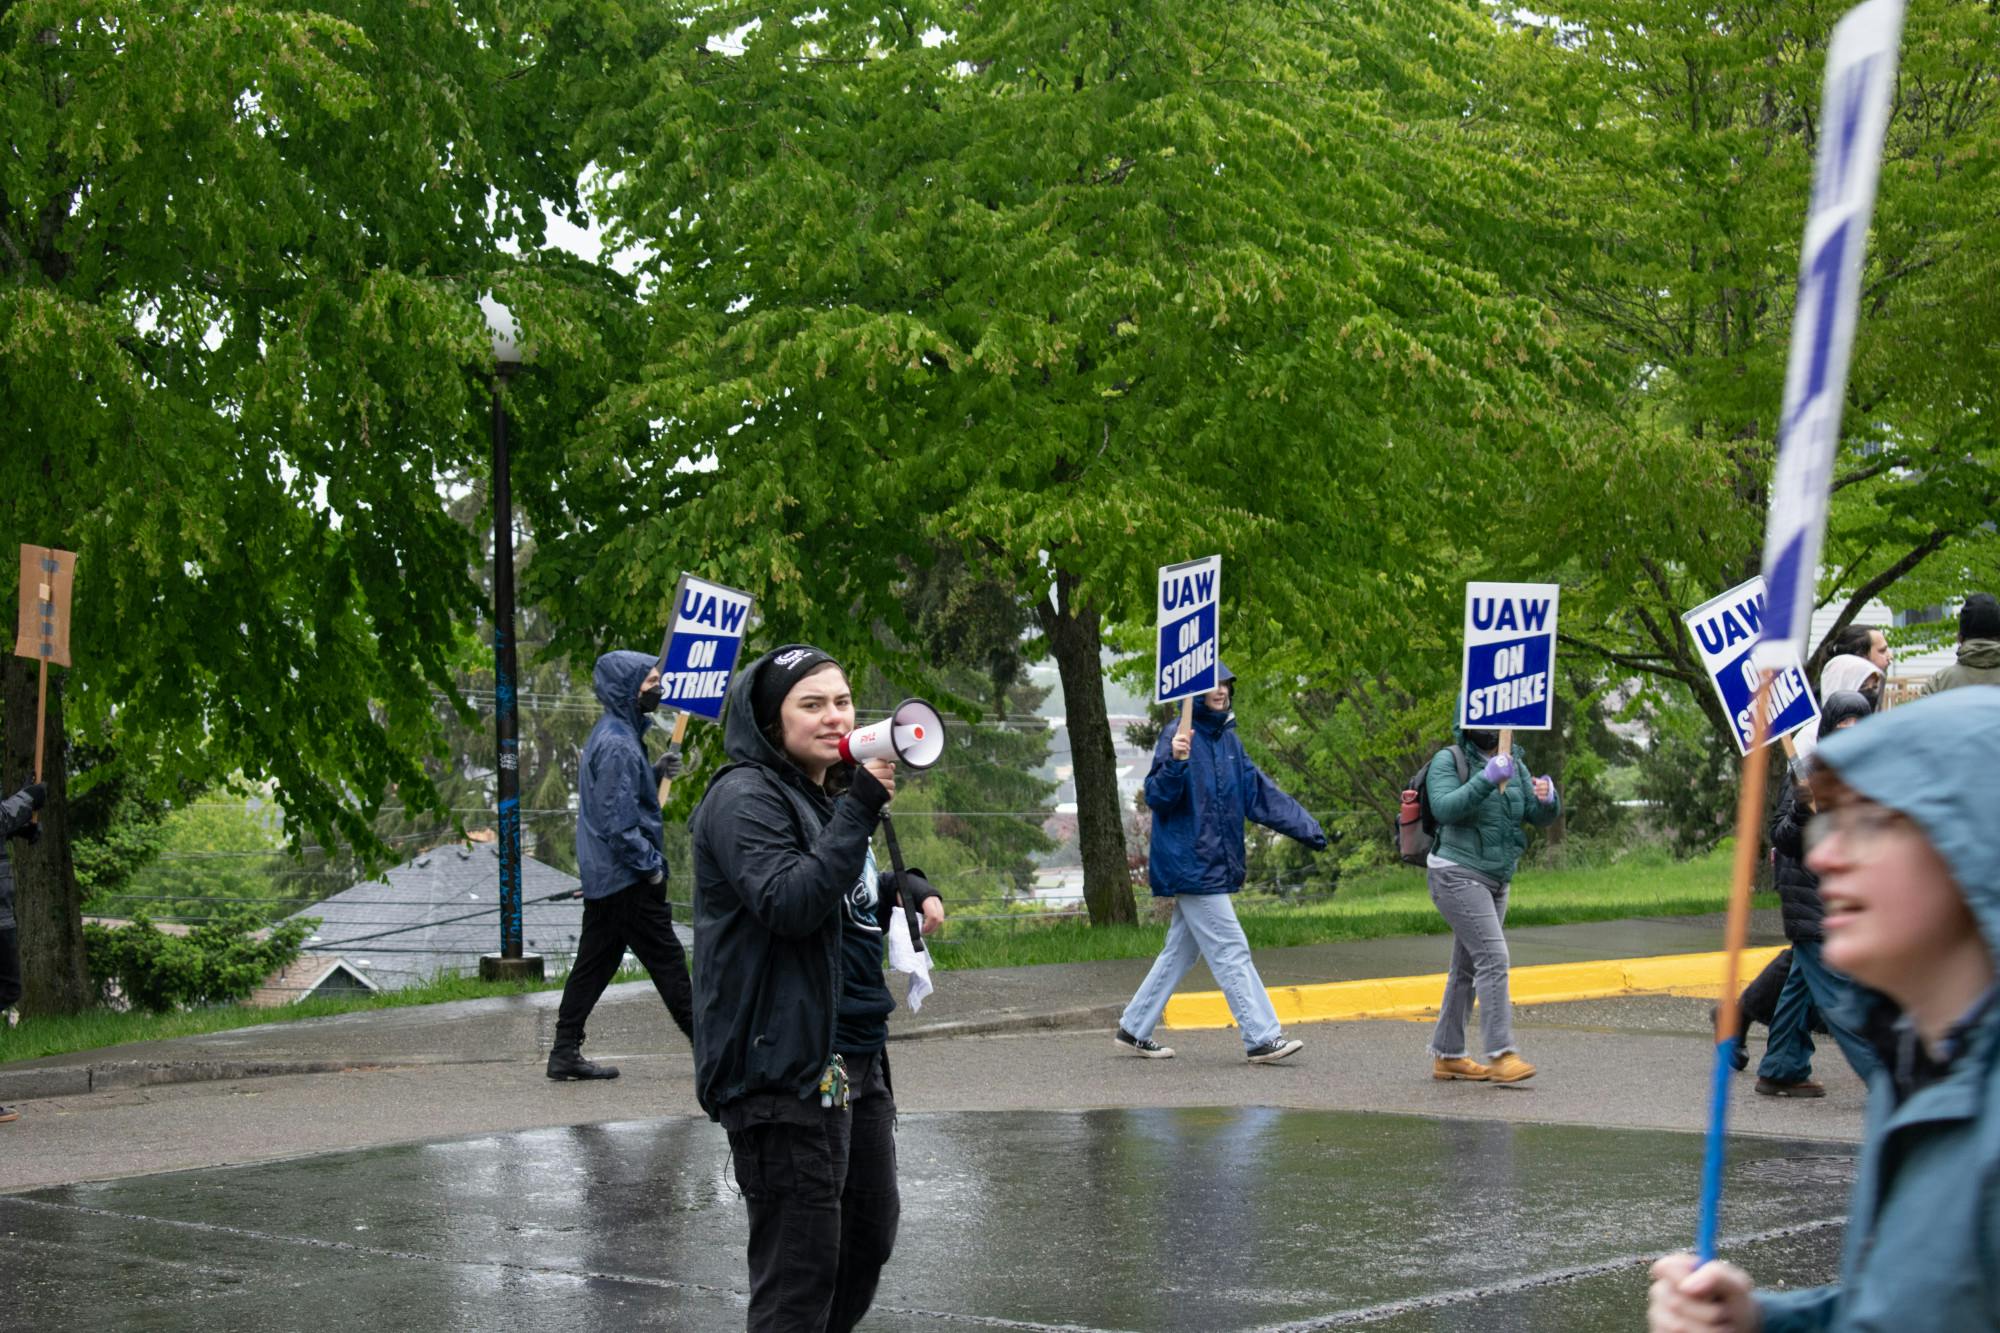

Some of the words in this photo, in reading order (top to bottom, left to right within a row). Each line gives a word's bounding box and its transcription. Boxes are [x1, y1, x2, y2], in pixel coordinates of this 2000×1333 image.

[1163, 569, 1215, 611] UAW
[679, 588, 747, 633] UAW
[1472, 597, 1551, 631] UAW
[1695, 592, 1766, 655] UAW
[1178, 615, 1200, 653] ON
[686, 640, 718, 669] ON
[1161, 636, 1214, 695] STRIKE
[1493, 643, 1525, 680] ON
[660, 670, 729, 700] STRIKE
[1468, 671, 1546, 721] STRIKE
